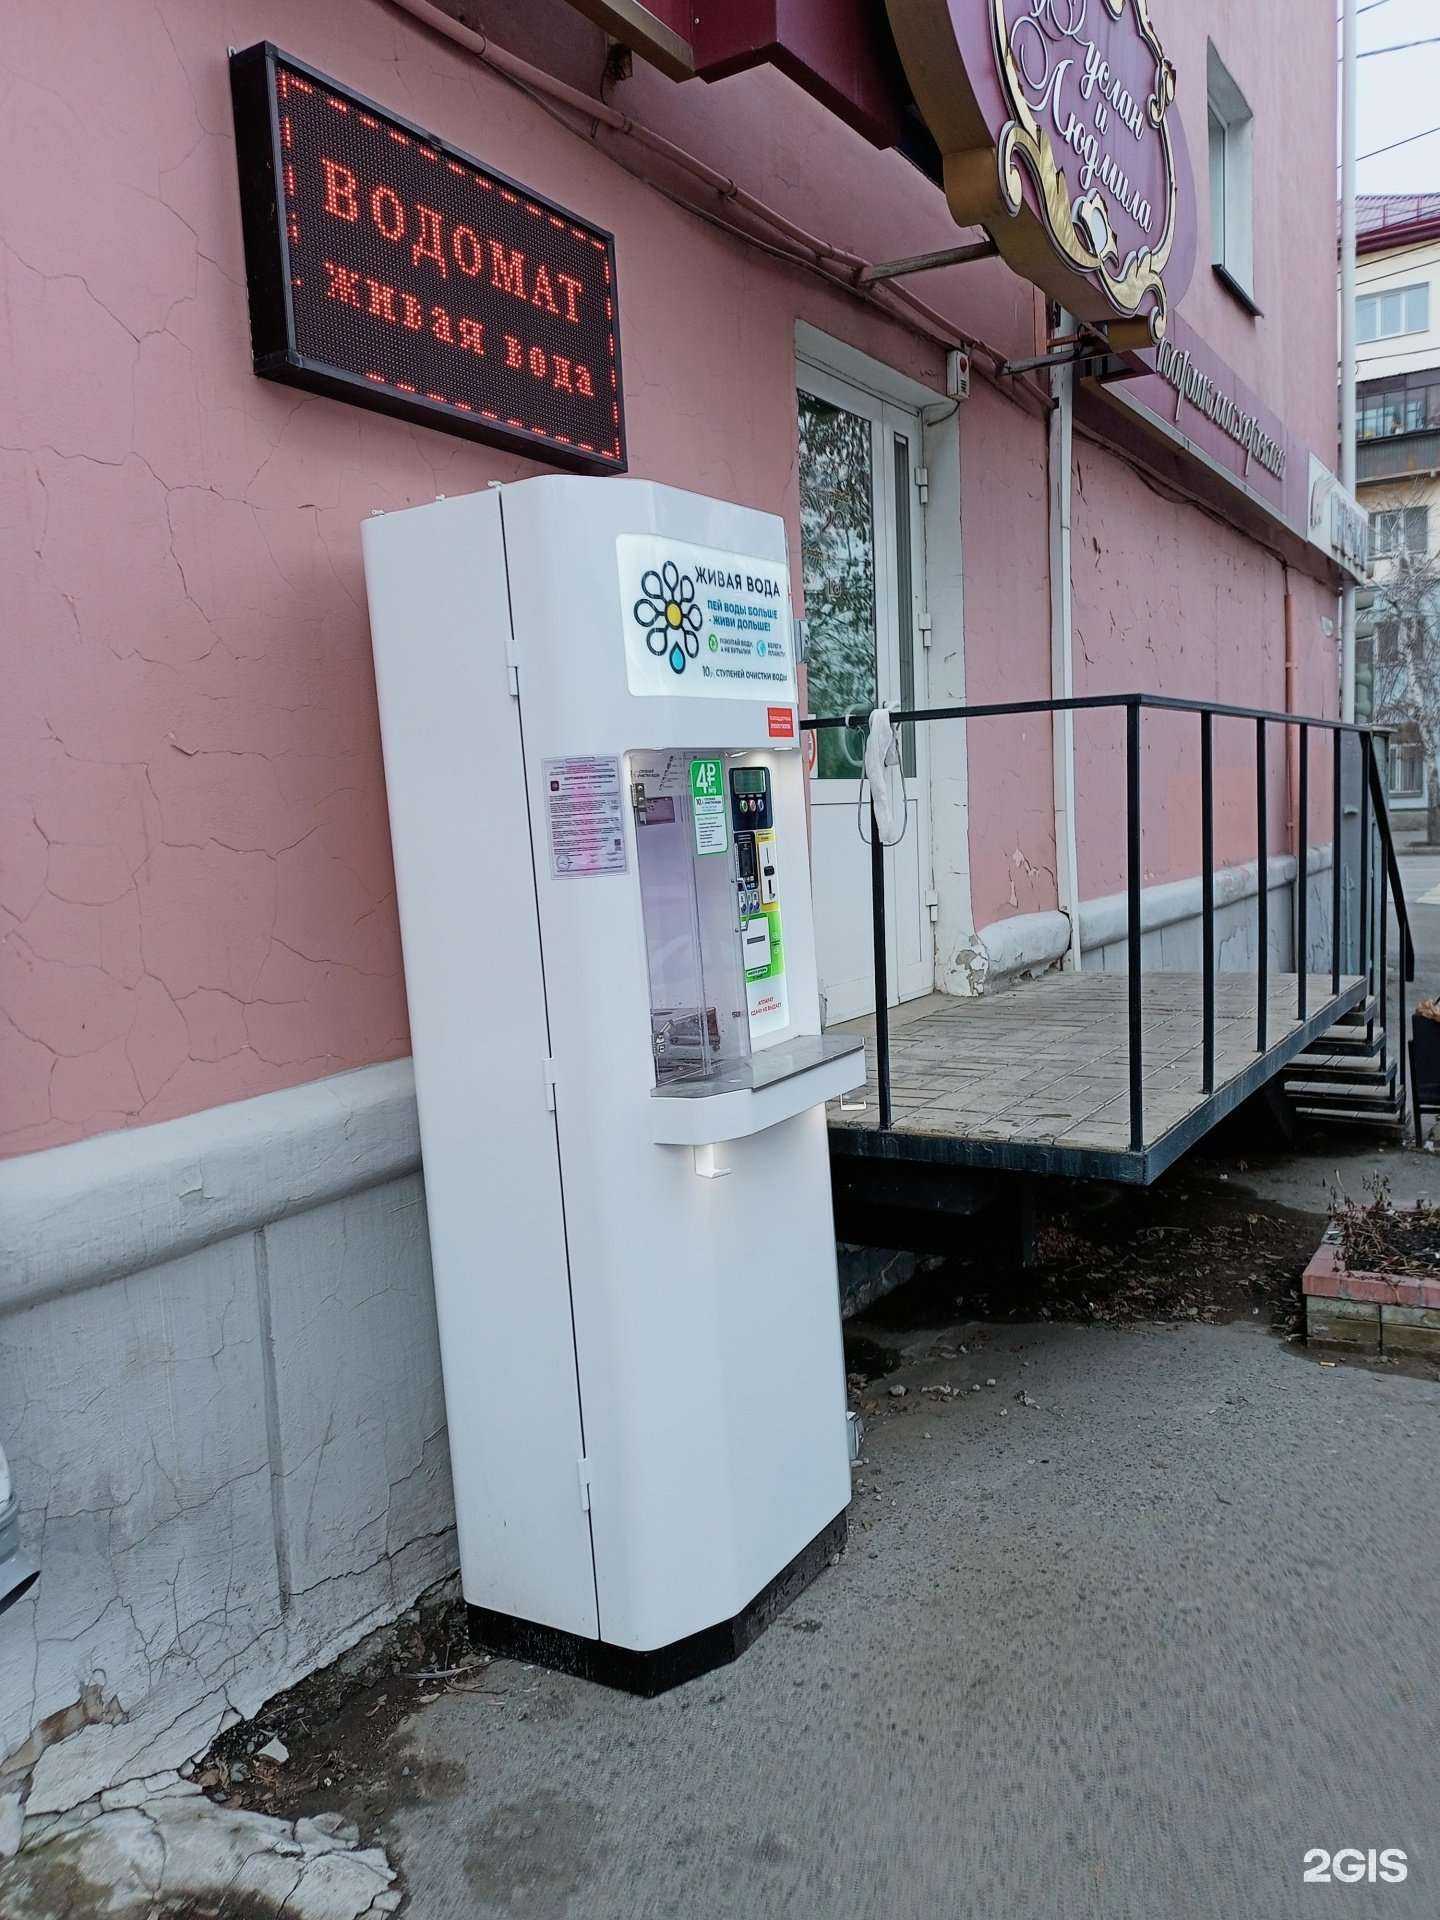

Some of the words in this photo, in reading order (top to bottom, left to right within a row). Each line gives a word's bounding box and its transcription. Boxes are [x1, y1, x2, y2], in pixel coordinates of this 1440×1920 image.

[1011, 16, 1153, 233] Людмила
[1094, 102, 1108, 135] и
[320, 259, 486, 357] живая
[504, 334, 594, 399] вода
[695, 565, 742, 591] ЖИВАЯ
[746, 575, 781, 599] ВОДА
[707, 599, 723, 612] ПЕЙ
[724, 602, 747, 616] ВОДЫ
[748, 606, 778, 620] БОЛЬШЕ
[713, 615, 736, 628] ЖИВИ
[737, 618, 771, 632] ДОЛЬШЕ!
[715, 668, 745, 680] СТУПЕНЕЙ
[745, 671, 771, 682] ОЧИСТКИ
